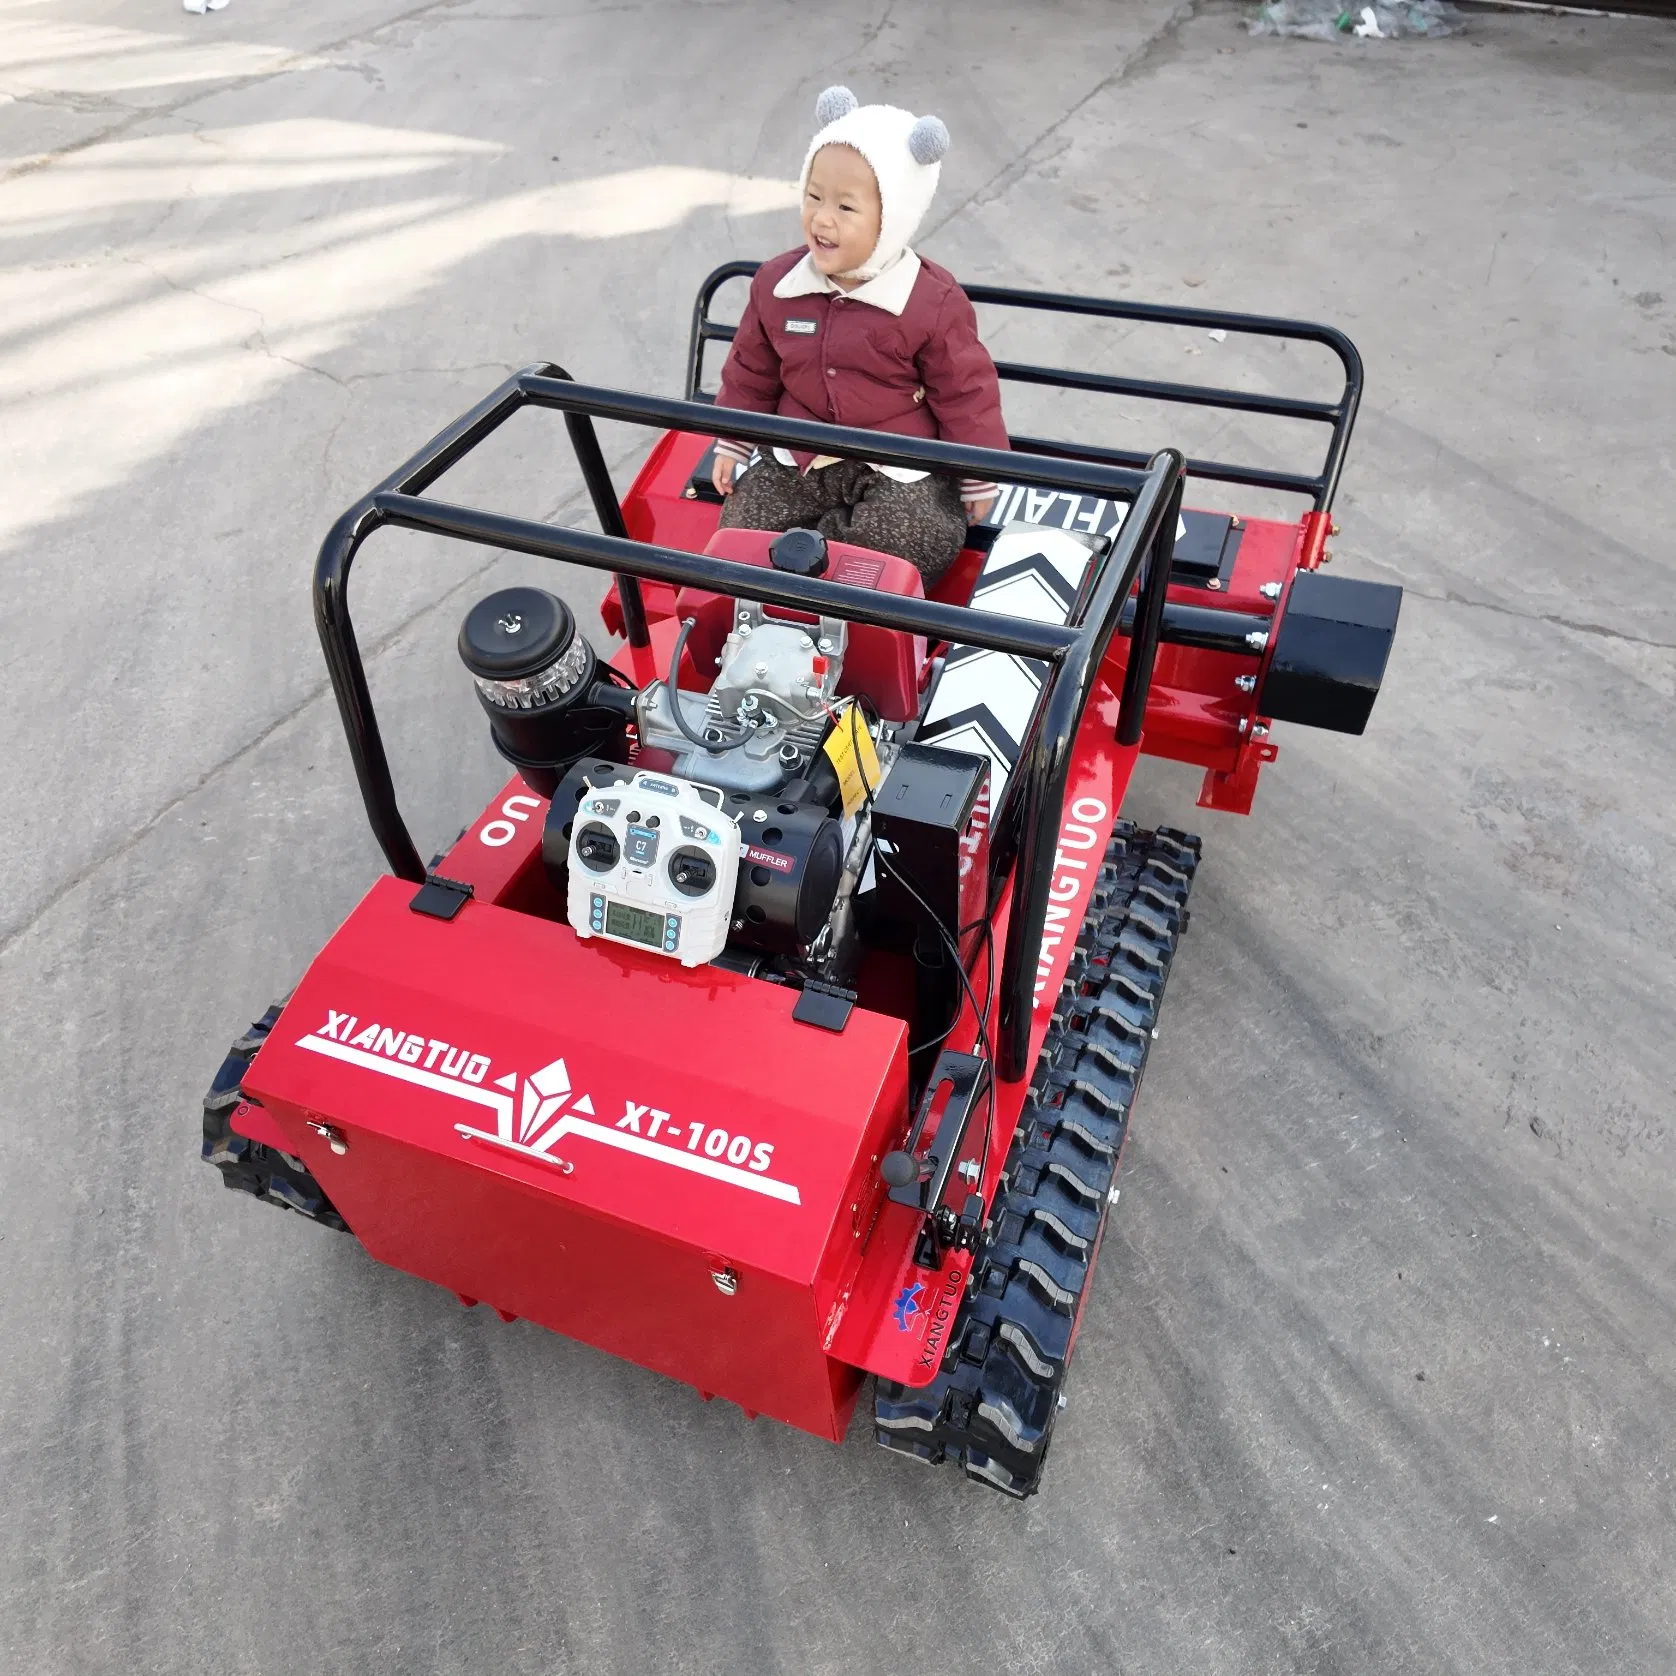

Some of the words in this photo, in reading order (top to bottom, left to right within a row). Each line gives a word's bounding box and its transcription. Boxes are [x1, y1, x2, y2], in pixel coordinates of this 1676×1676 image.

[636, 840, 647, 851] C7
[749, 850, 788, 868] MUFFLER
[316, 1009, 492, 1084] XIANGTUO
[615, 1101, 775, 1172] XT-100S
[918, 1269, 962, 1369] XIANGTUO
